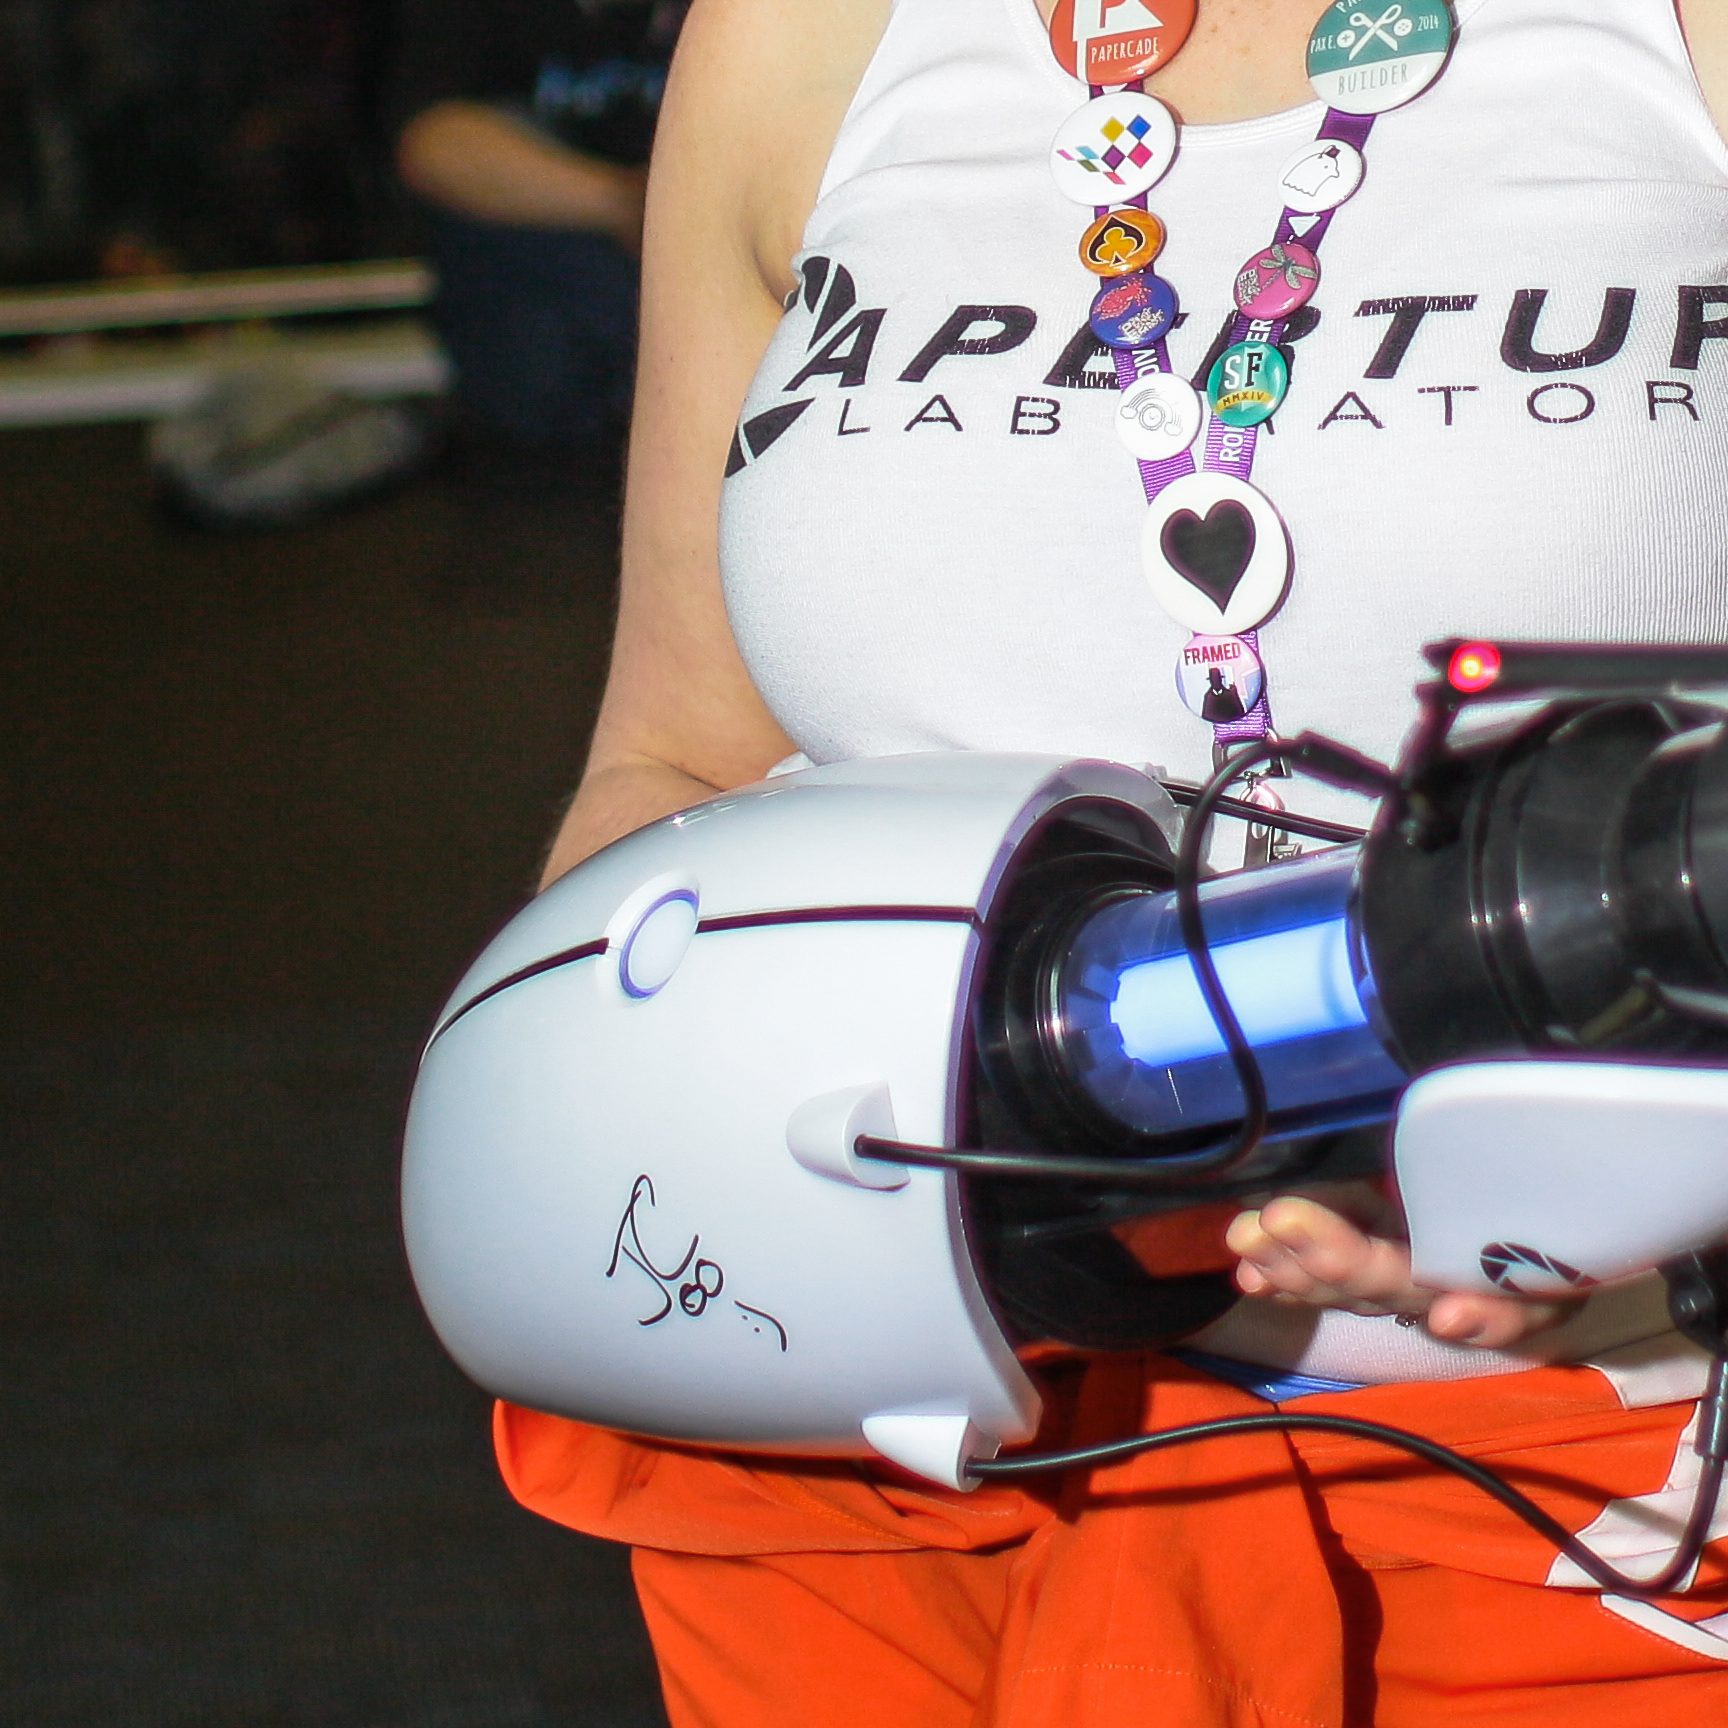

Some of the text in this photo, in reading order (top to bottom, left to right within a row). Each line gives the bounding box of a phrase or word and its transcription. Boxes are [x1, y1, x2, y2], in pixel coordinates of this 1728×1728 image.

[1417, 15, 1440, 32] 2014
[1091, 36, 1160, 64] PAPERCADE
[1338, 63, 1408, 96] BUILDER
[1222, 391, 1265, 407] MMXIV
[1183, 641, 1242, 666] FRAMED
